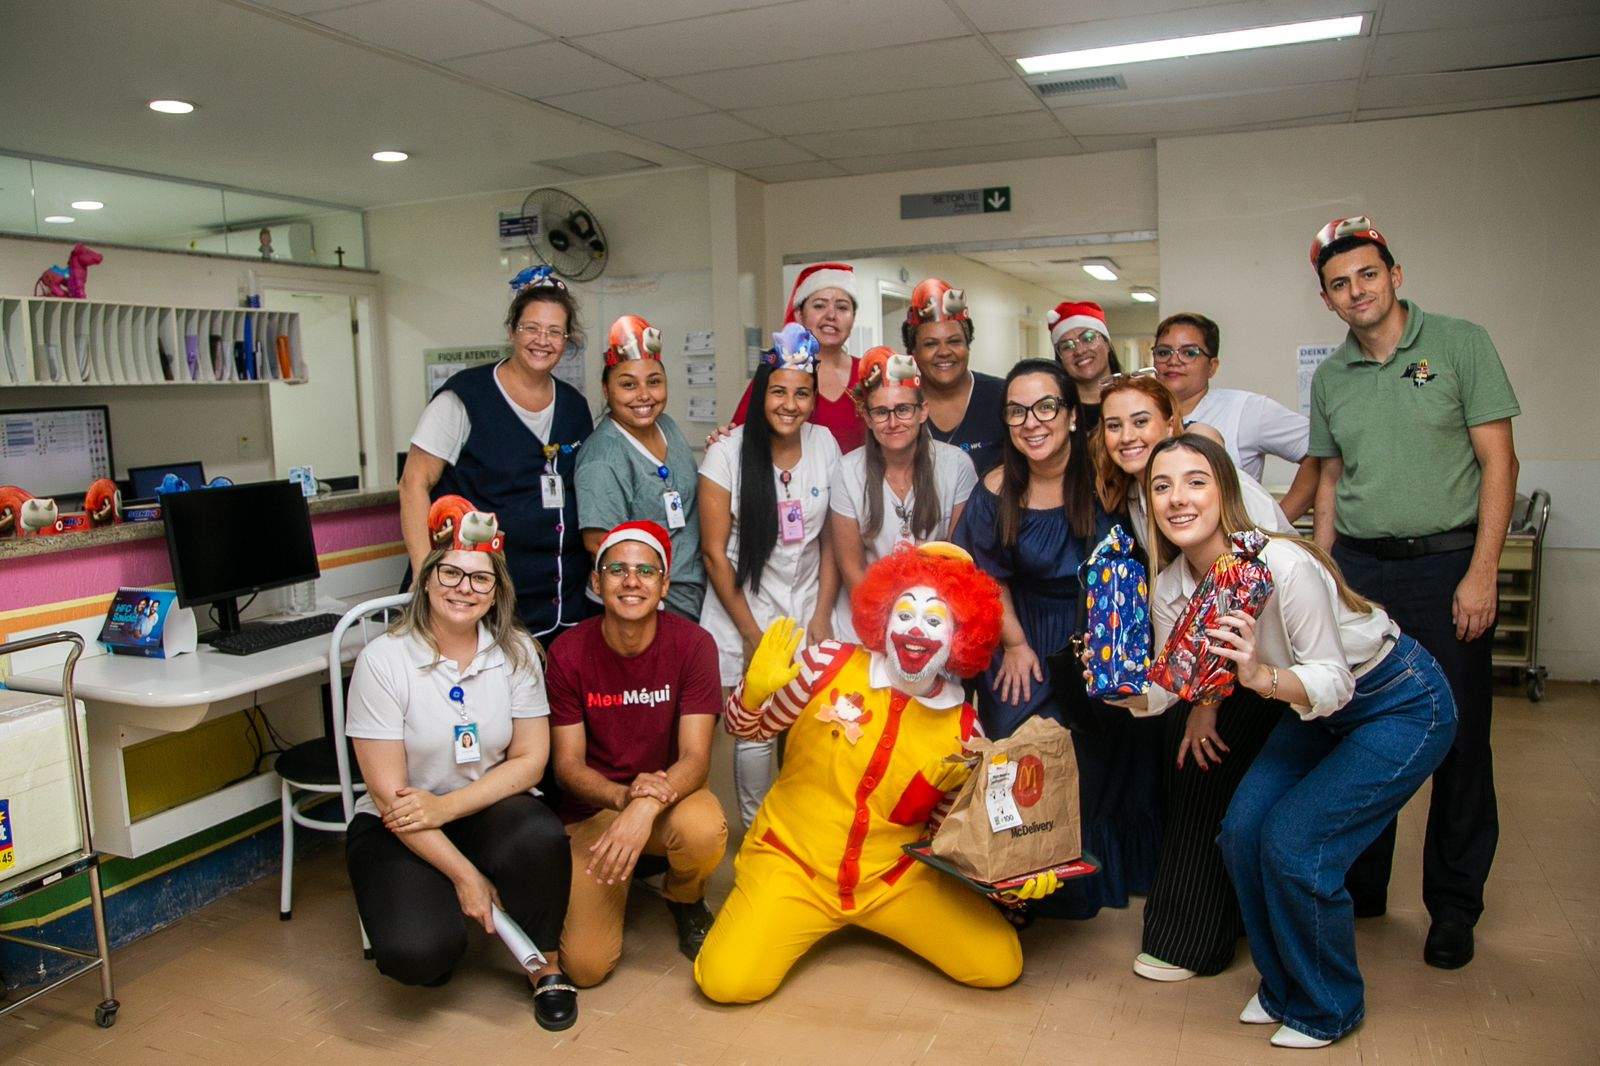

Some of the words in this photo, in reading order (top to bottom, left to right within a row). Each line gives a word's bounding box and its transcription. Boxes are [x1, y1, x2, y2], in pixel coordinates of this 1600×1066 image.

[438, 352, 462, 361] FIQUE
[1300, 348, 1328, 356] DEIXE
[1010, 820, 1054, 838] McDelivery
